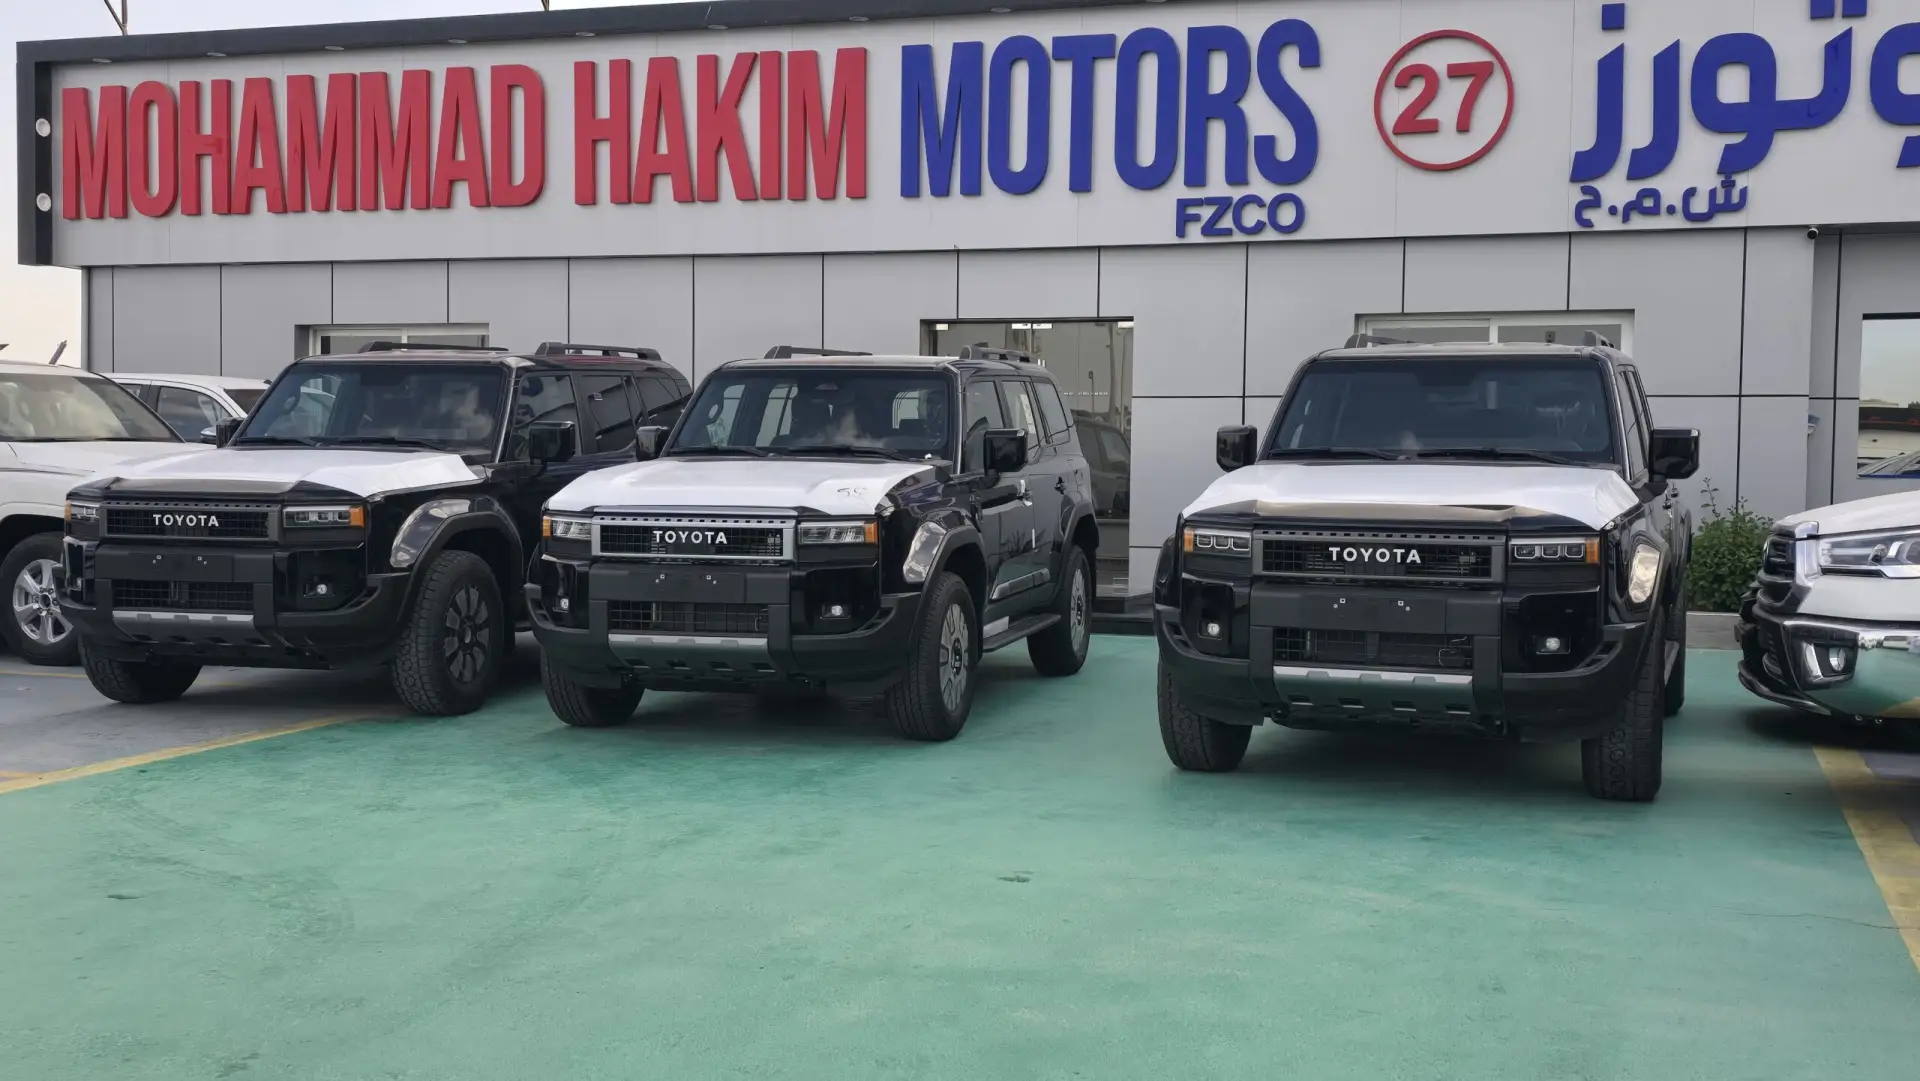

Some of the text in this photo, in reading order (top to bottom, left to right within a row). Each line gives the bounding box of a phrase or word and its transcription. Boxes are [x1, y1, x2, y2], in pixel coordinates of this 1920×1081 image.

[1392, 61, 1494, 134] 27
[61, 19, 1321, 220] MOHAMMAD HAKIM MOTORS
[1176, 193, 1305, 237] FZCO
[152, 513, 220, 528] TOYOTA
[652, 529, 728, 545] TOYOTA
[1328, 546, 1422, 565] TOYOTA
